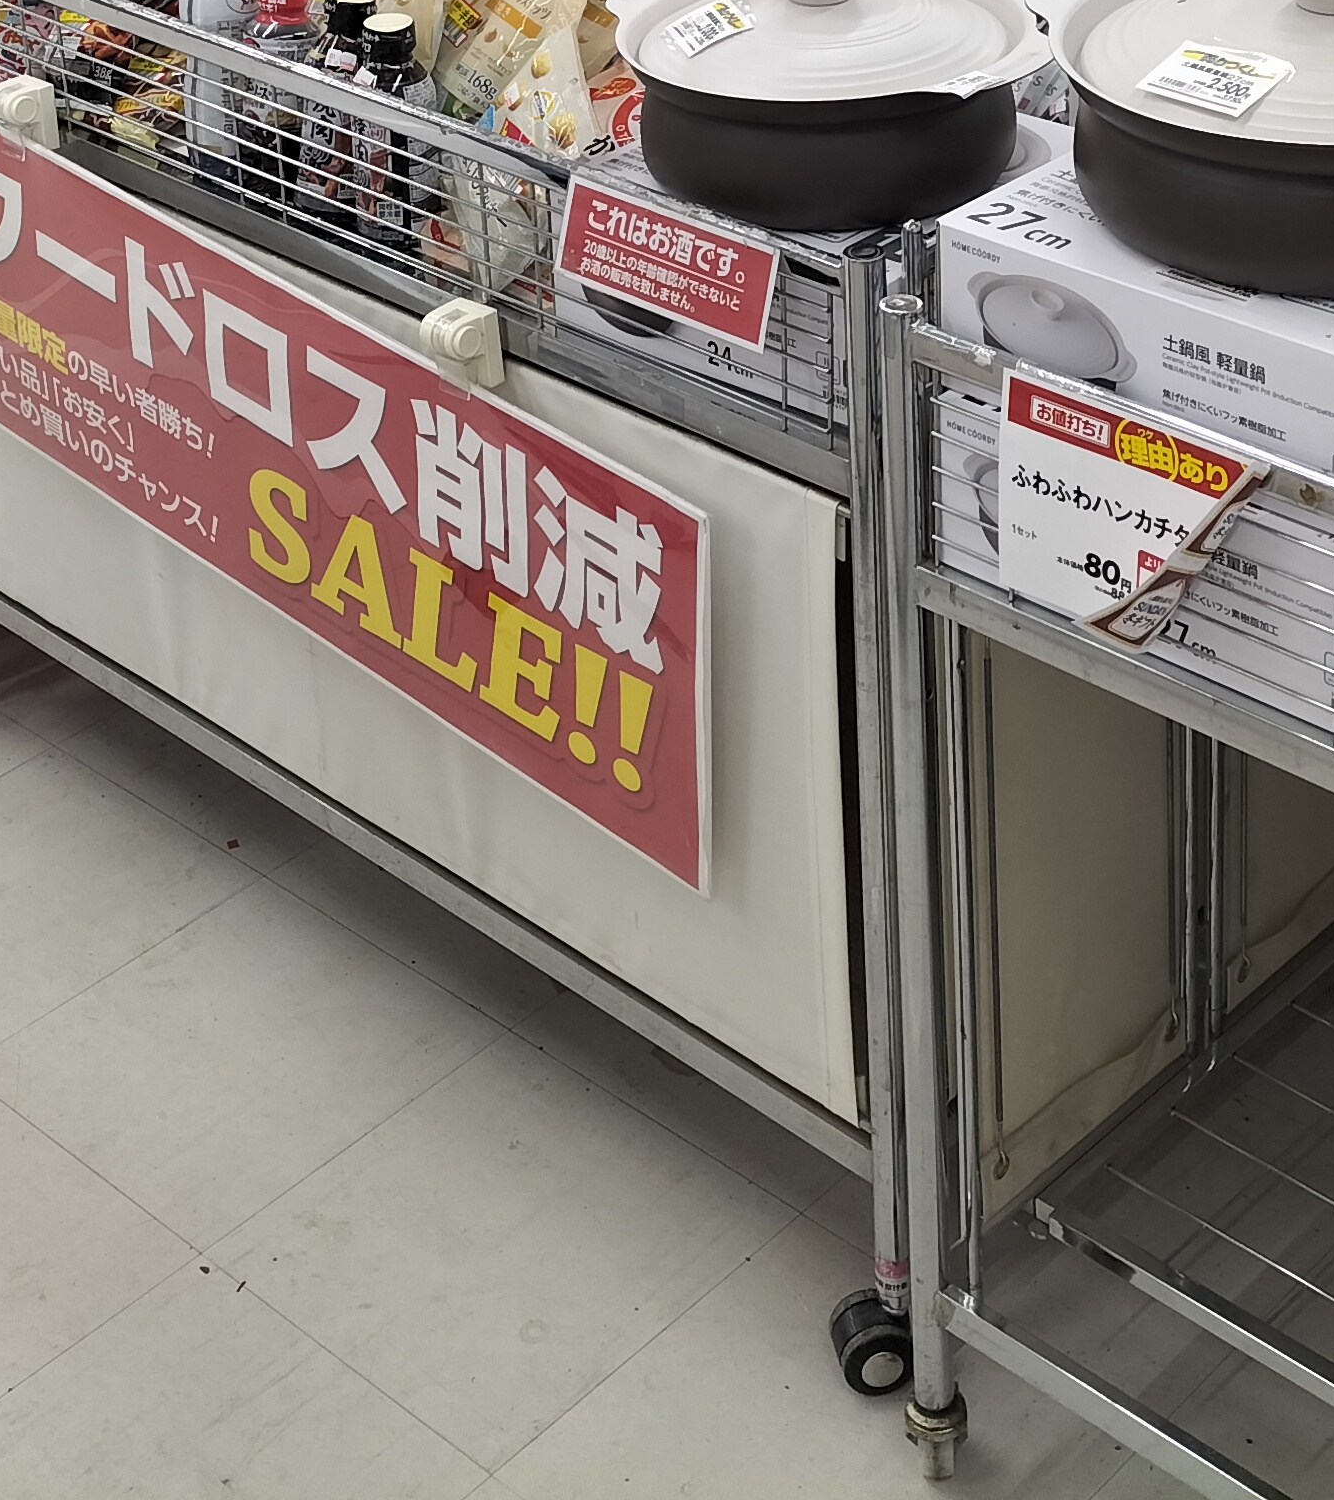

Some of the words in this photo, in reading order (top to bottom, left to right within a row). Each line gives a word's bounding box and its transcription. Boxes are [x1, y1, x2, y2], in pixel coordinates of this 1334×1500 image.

[469, 69, 497, 98] 168g
[587, 200, 745, 284] これはお酒です。
[580, 257, 696, 313] お酒の販売を致しません。
[583, 240, 741, 311] 20歳以上の年齢確認ができないと
[1163, 334, 1210, 365] 土鍋風
[1216, 351, 1266, 385] 軽量鍋
[1036, 403, 1105, 441] お値打ち!
[1120, 433, 1229, 491] 理由あり
[1012, 523, 1038, 540] 1セット
[247, 469, 653, 794] SALE!!
